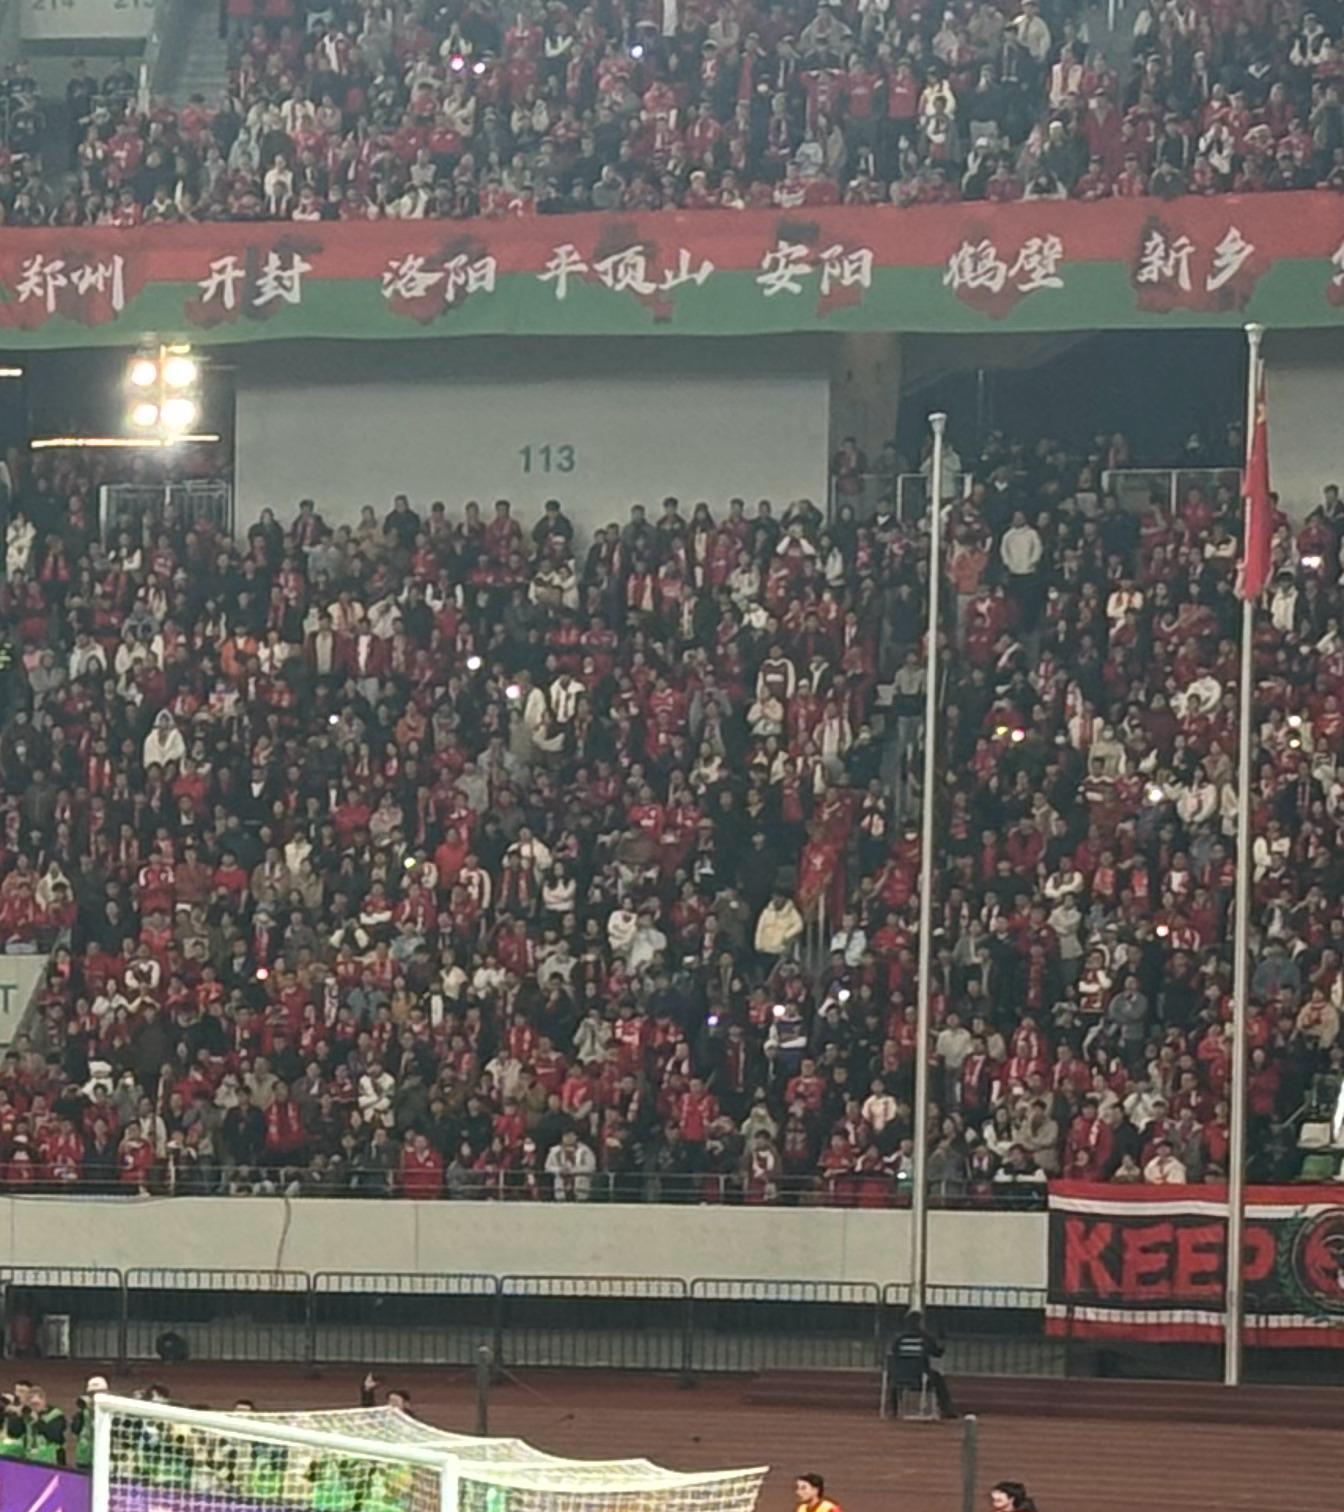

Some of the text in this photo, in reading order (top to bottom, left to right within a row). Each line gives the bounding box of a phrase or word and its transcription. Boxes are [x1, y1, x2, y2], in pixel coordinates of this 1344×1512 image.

[15, 226, 1255, 312] 郑州 开封 洛阳 平顶山 安阳 鹤壁 新乡
[519, 444, 575, 473] 113
[1064, 1217, 1276, 1300] KEEP
